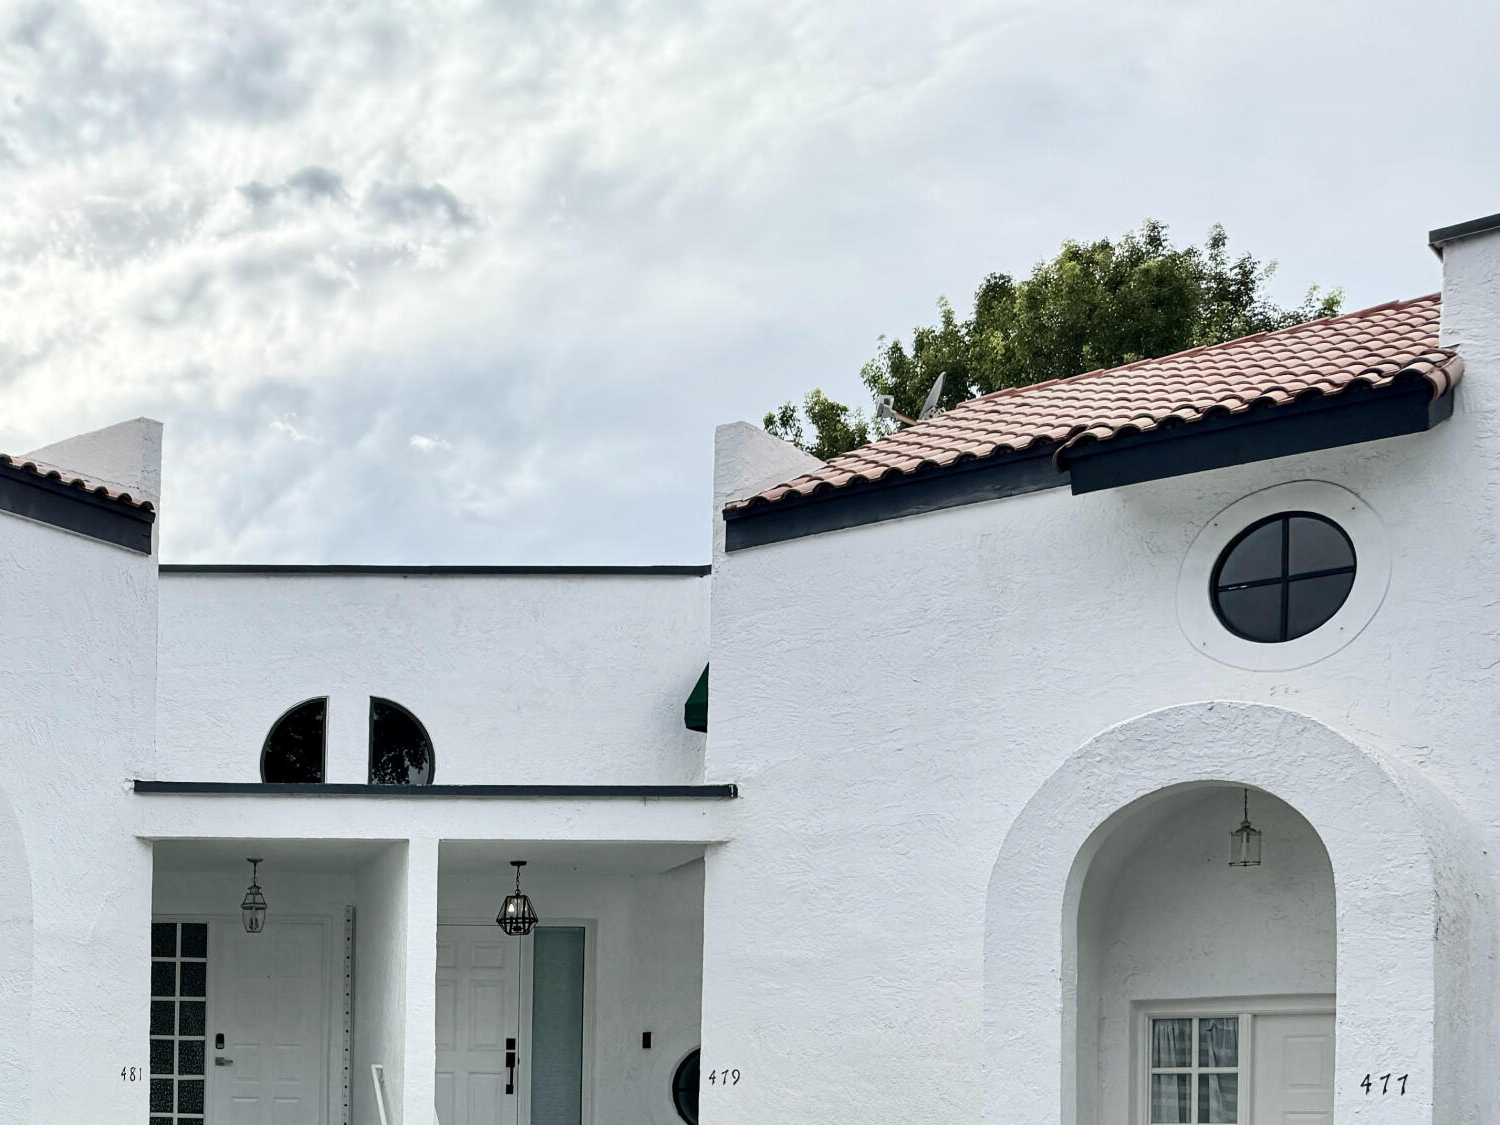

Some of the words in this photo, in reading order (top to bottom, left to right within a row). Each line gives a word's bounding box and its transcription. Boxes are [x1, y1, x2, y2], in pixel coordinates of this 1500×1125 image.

[120, 1066, 142, 1082] 481
[708, 1068, 741, 1086] 479
[1360, 1073, 1409, 1096] 477
